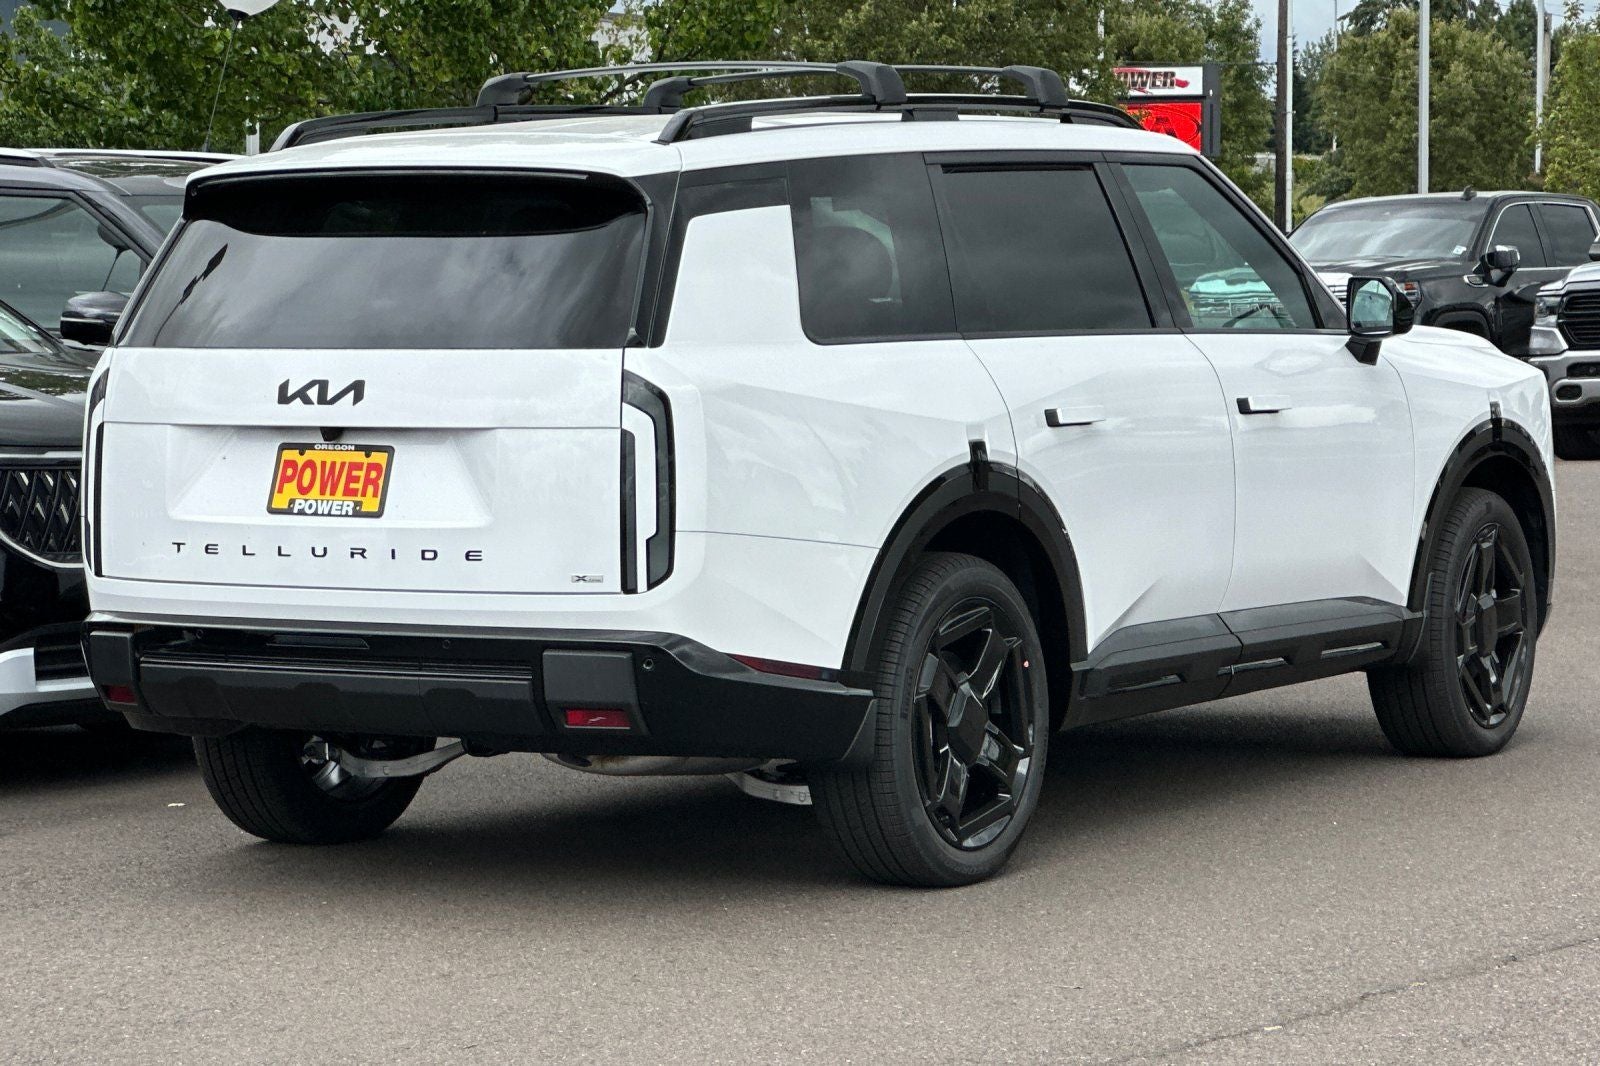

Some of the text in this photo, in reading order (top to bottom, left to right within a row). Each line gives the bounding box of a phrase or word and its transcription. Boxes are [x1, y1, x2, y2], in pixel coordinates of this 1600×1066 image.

[1115, 70, 1176, 89] WER
[277, 378, 365, 406] KIA
[276, 459, 384, 498] POWER
[293, 499, 355, 516] POWER
[172, 542, 483, 562] TELLURIDE
